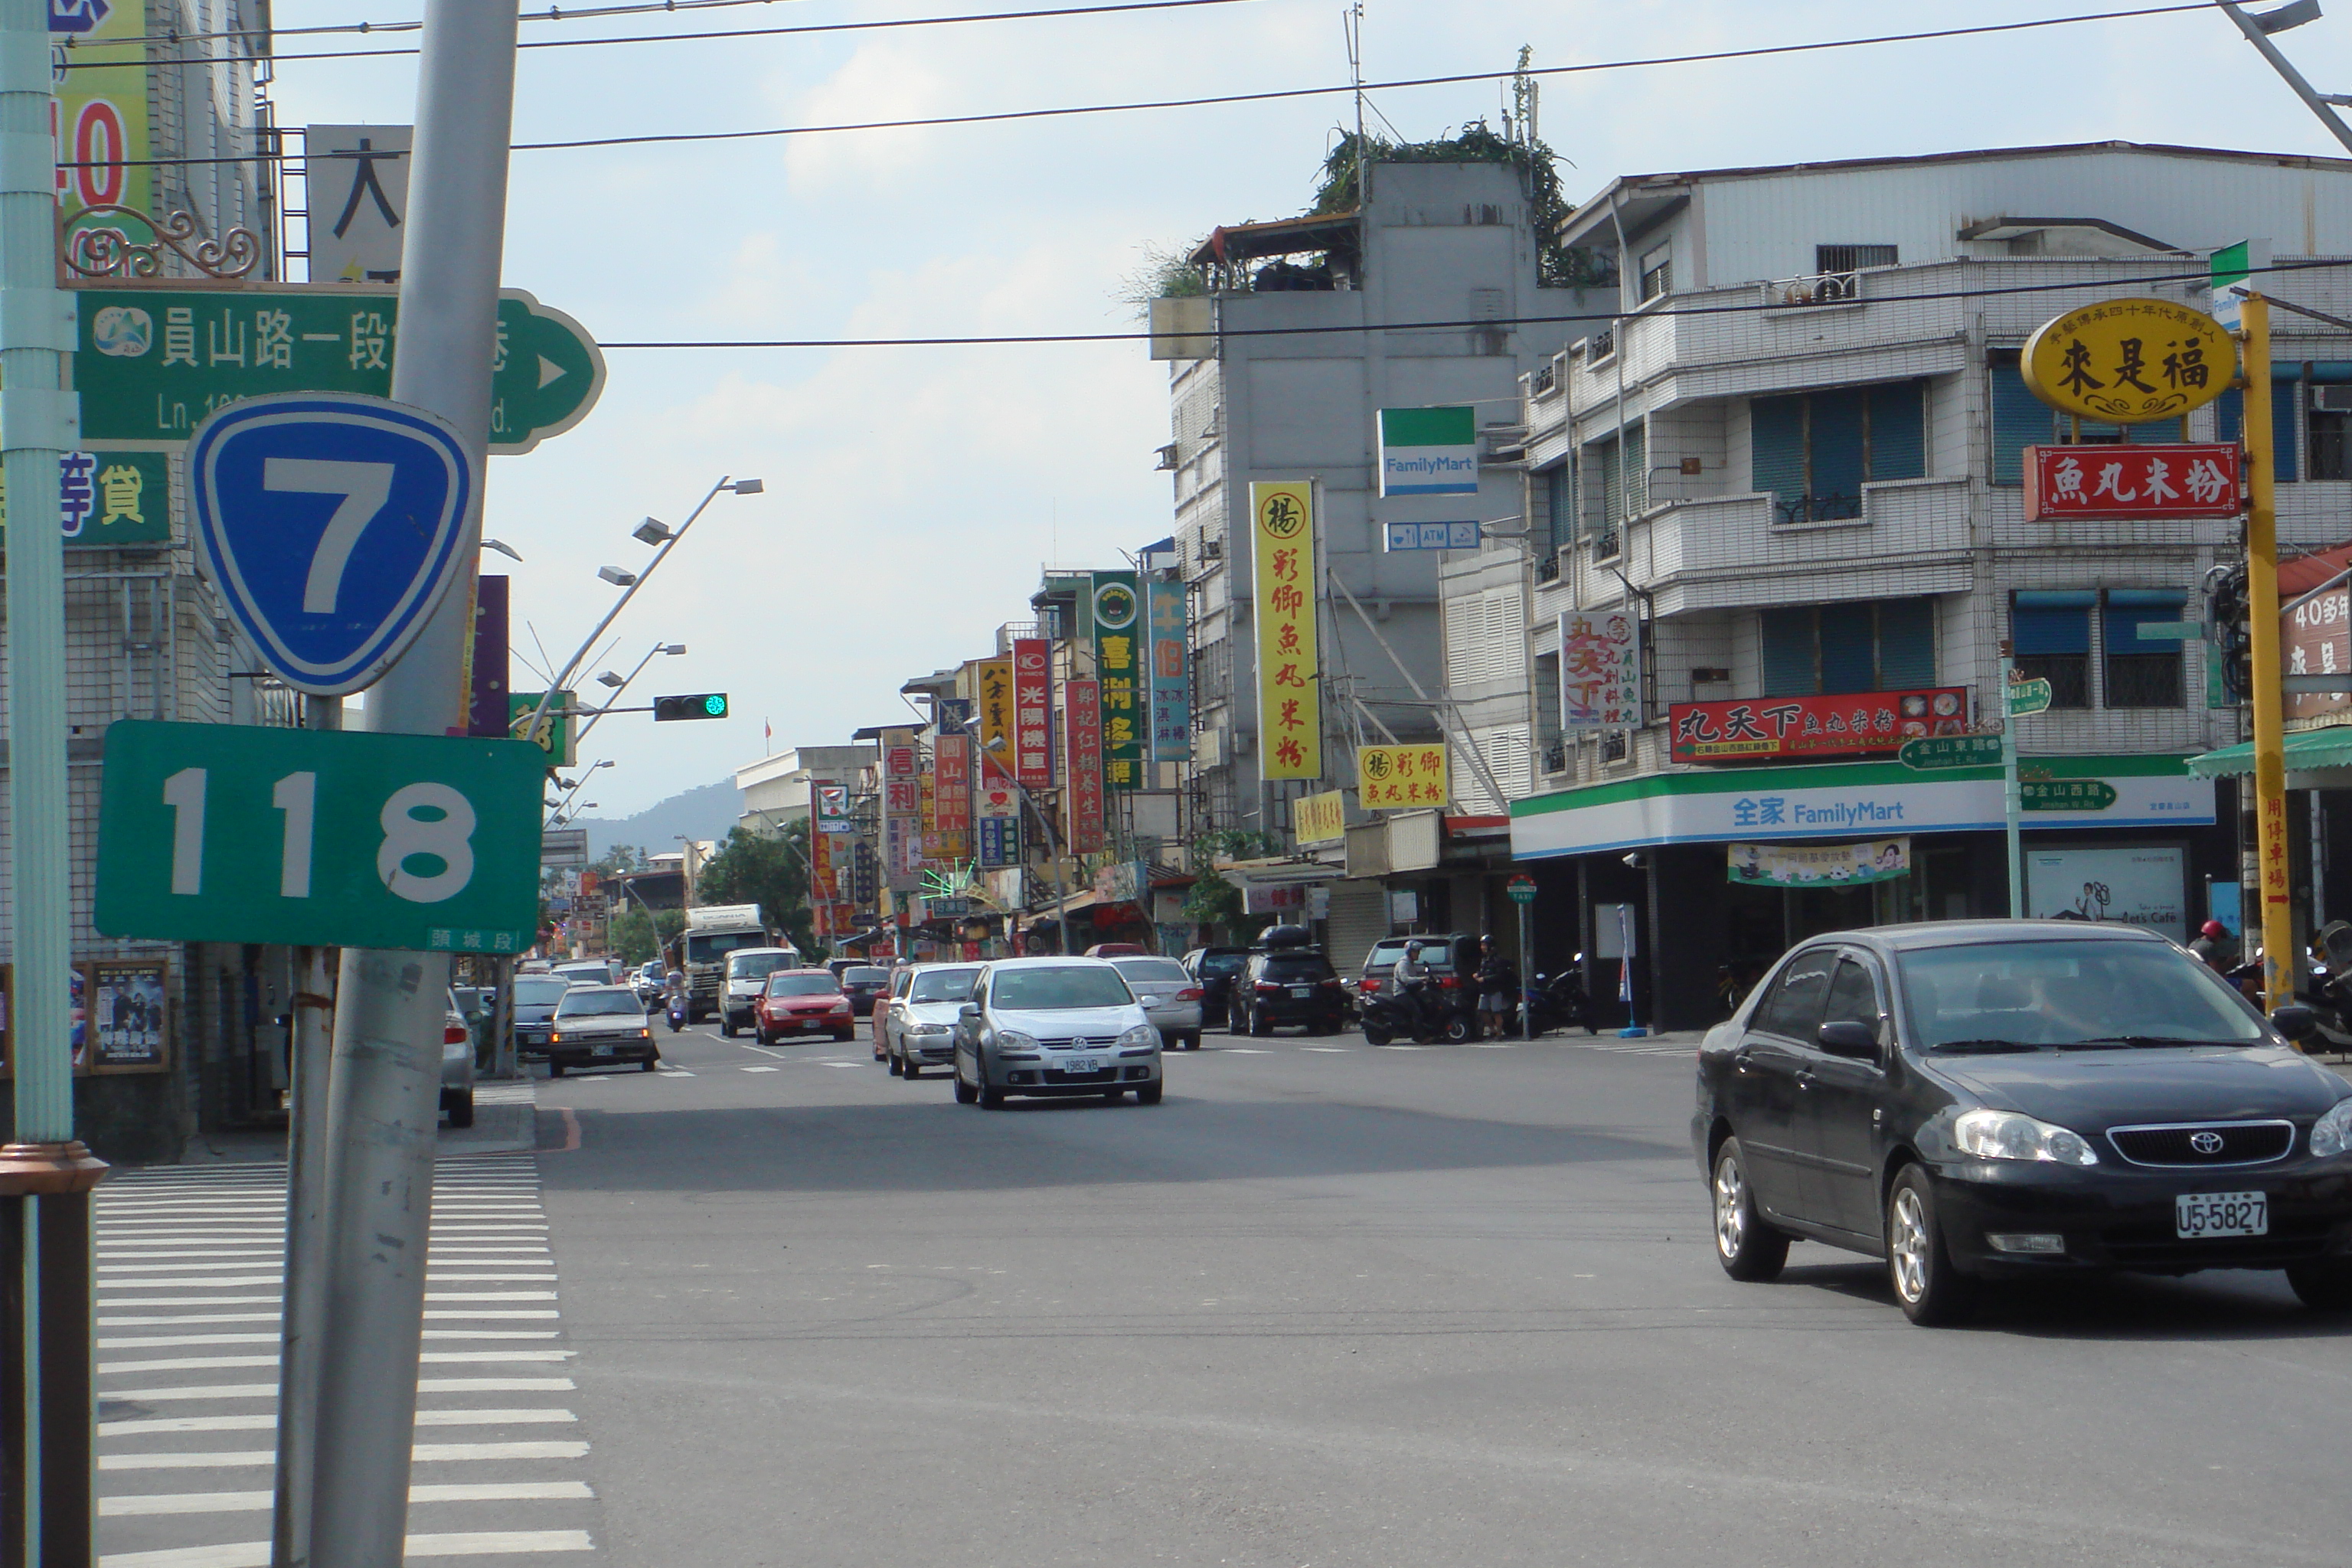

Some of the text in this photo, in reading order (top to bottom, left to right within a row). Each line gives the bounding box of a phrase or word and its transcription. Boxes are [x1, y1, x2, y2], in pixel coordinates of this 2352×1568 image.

[2057, 337, 2209, 397] 來是福
[1387, 456, 1472, 475] FamilyMart
[2051, 456, 2230, 505] 魚丸米粉
[263, 458, 397, 614] 7
[1424, 529, 1444, 541] ATM
[1566, 616, 1603, 705] 丸天下
[1020, 686, 1046, 769] 光陽機車
[1677, 704, 1802, 743] 丸天下
[1919, 738, 1985, 755] 金山東路
[887, 748, 917, 810] 信利
[2037, 784, 2100, 797] 金山西路
[1733, 797, 1904, 827] 全家 FamilyMart
[431, 929, 512, 950] 頭城段
[2178, 1201, 2265, 1231] U5-5827
